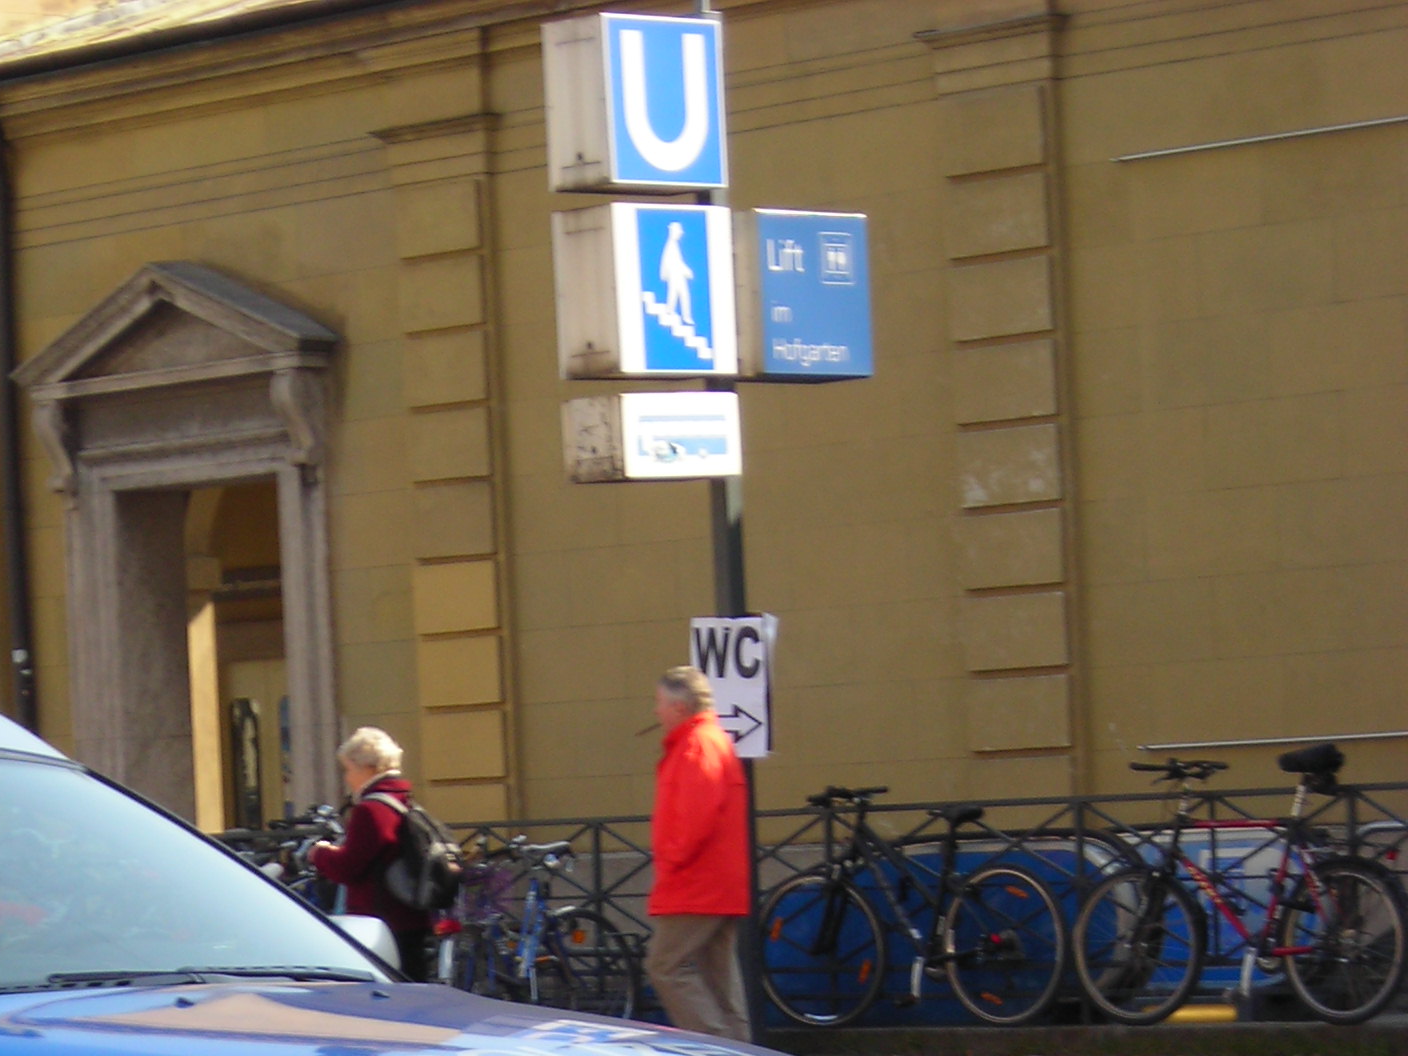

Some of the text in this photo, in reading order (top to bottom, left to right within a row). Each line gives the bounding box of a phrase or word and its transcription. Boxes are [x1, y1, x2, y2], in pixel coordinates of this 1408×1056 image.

[619, 29, 710, 172] U
[766, 239, 805, 273] Lift
[770, 300, 792, 322] im
[693, 626, 761, 678] WC
